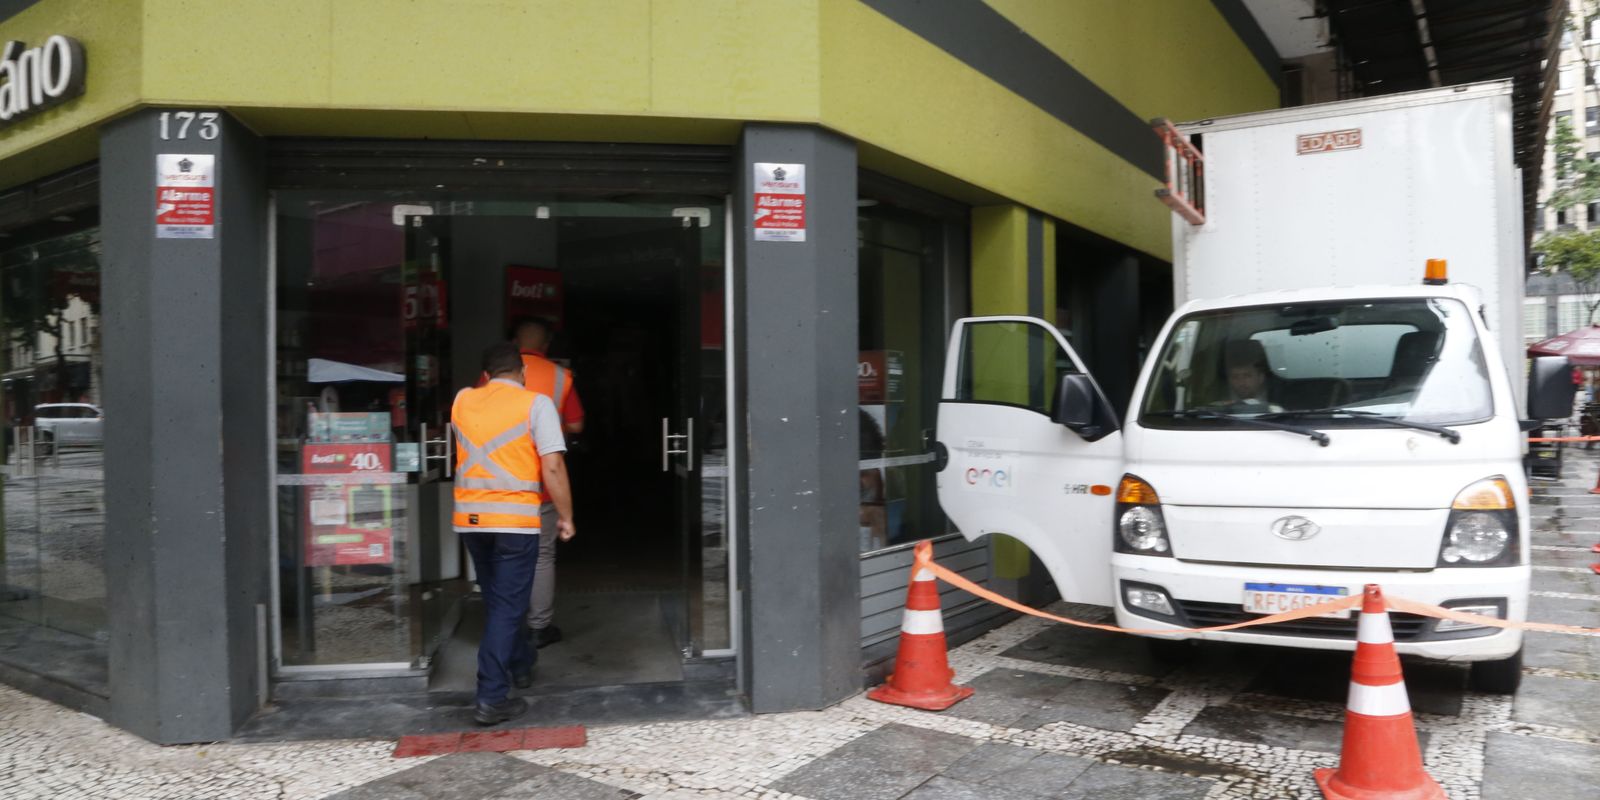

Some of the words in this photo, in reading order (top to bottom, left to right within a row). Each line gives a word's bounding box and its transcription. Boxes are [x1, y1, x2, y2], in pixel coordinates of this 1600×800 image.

[159, 111, 220, 140] 173
[1299, 131, 1361, 151] EDARP
[160, 189, 211, 201] Alarme
[759, 196, 803, 208] Alarme
[510, 279, 545, 299] boti
[965, 465, 1012, 488] enel
